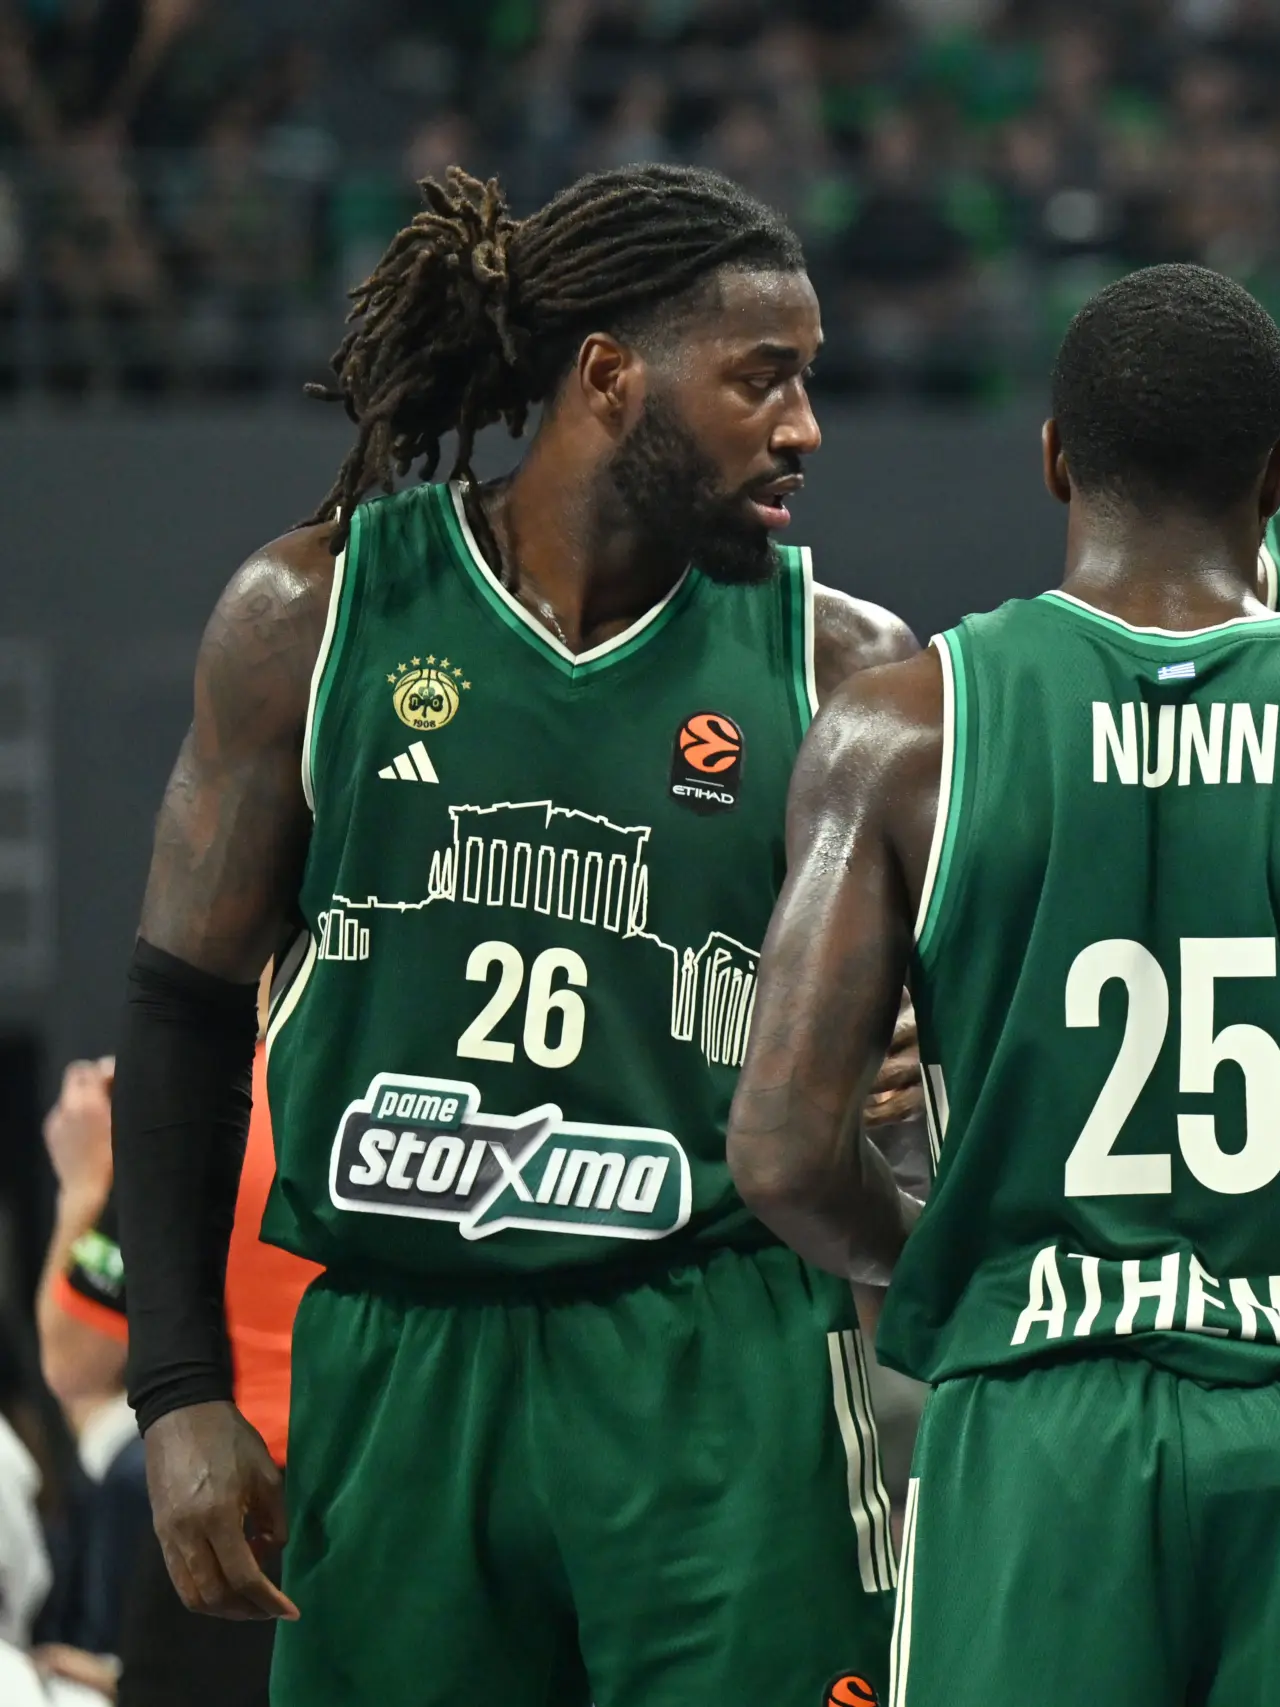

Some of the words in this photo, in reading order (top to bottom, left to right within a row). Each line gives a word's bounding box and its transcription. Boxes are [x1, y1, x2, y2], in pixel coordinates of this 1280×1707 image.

[1092, 701, 1279, 788] NUNN
[672, 784, 735, 805] ETIHAD
[456, 940, 588, 1069] 26
[377, 1091, 459, 1122] pame
